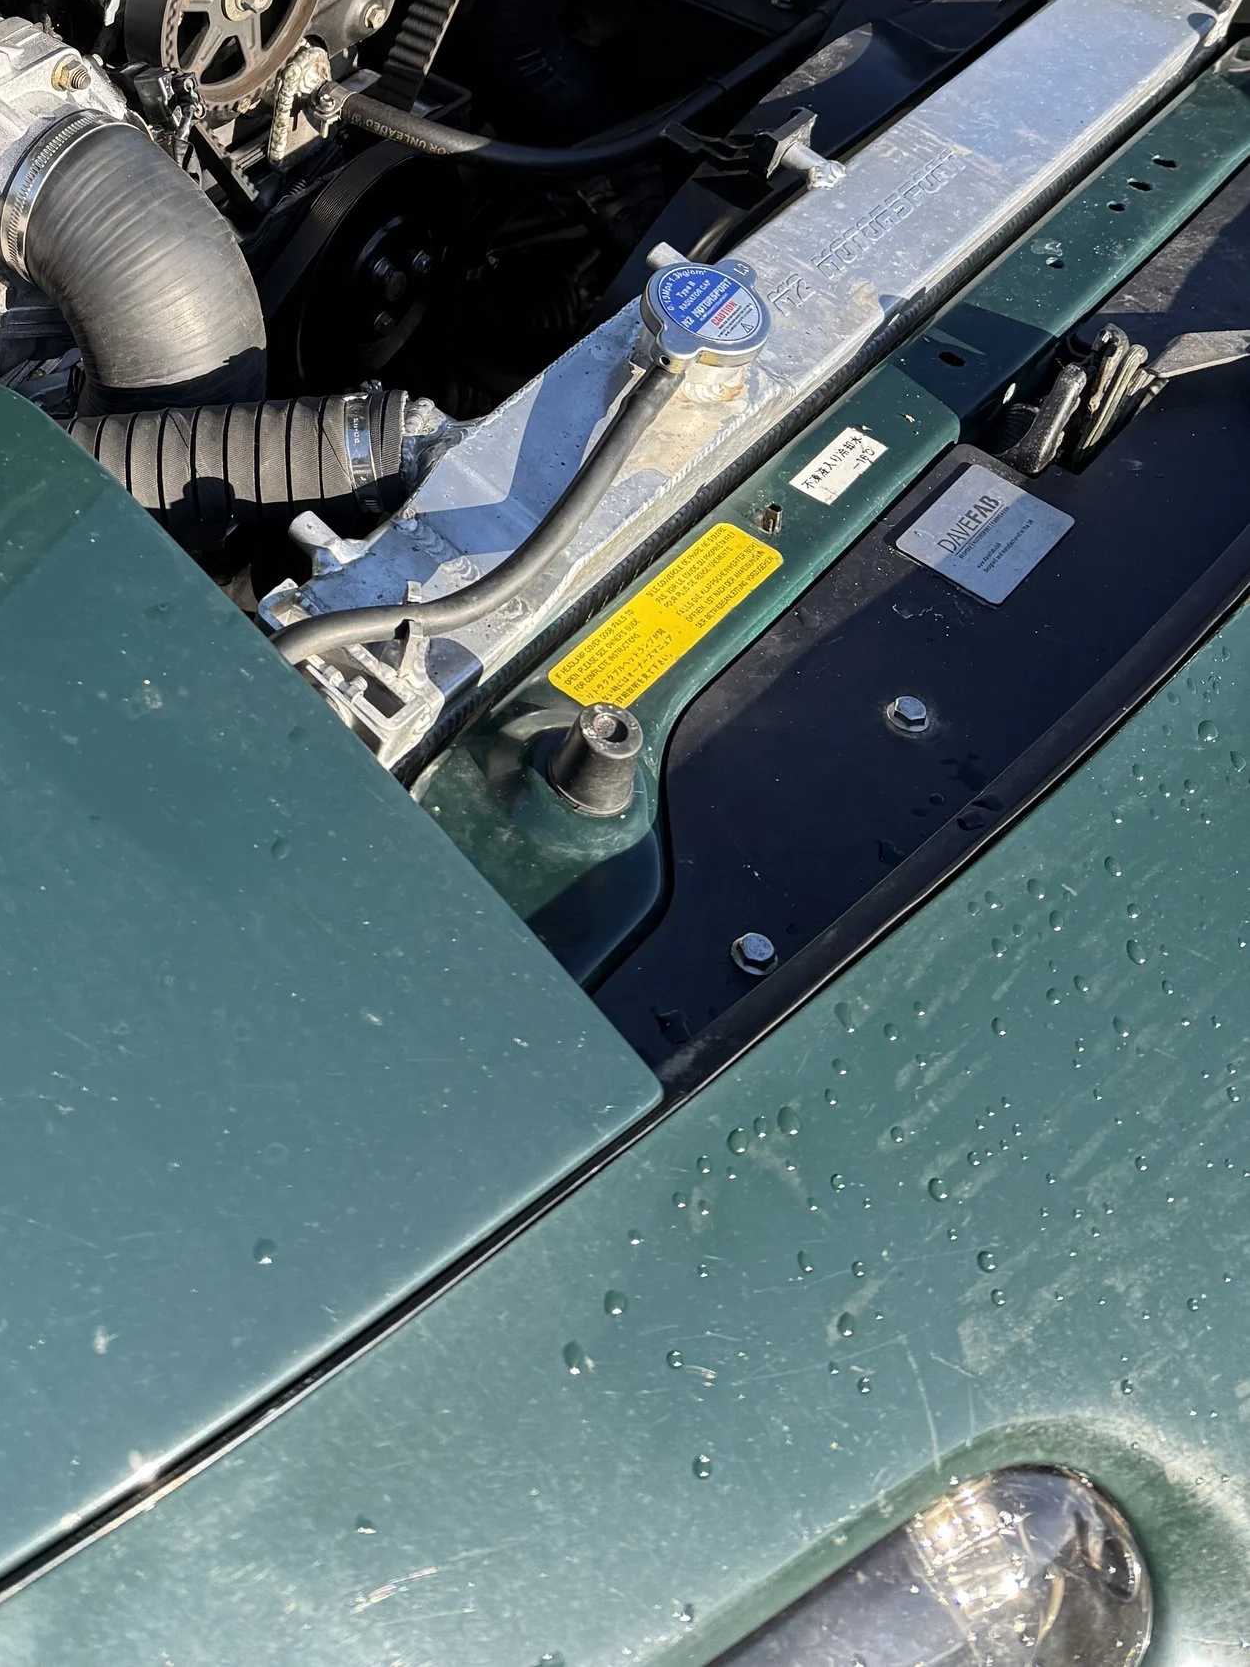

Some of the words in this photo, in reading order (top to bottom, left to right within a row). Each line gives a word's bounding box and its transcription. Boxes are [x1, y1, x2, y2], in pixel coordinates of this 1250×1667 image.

[364, 118, 428, 148] UNLEADED
[811, 147, 967, 280] MOTORSPORT
[675, 282, 693, 299] Type
[678, 287, 704, 312] RADIATOR
[699, 279, 711, 290] CAP
[680, 315, 694, 328] M2
[689, 277, 733, 318] MOTORSPORT
[709, 299, 738, 326] CAUTION
[935, 493, 1002, 553] DAVEFAB
[571, 681, 587, 692] FOR
[582, 659, 611, 683] COMPLETE
[575, 656, 599, 673] PLEASE
[593, 647, 608, 657] SEE
